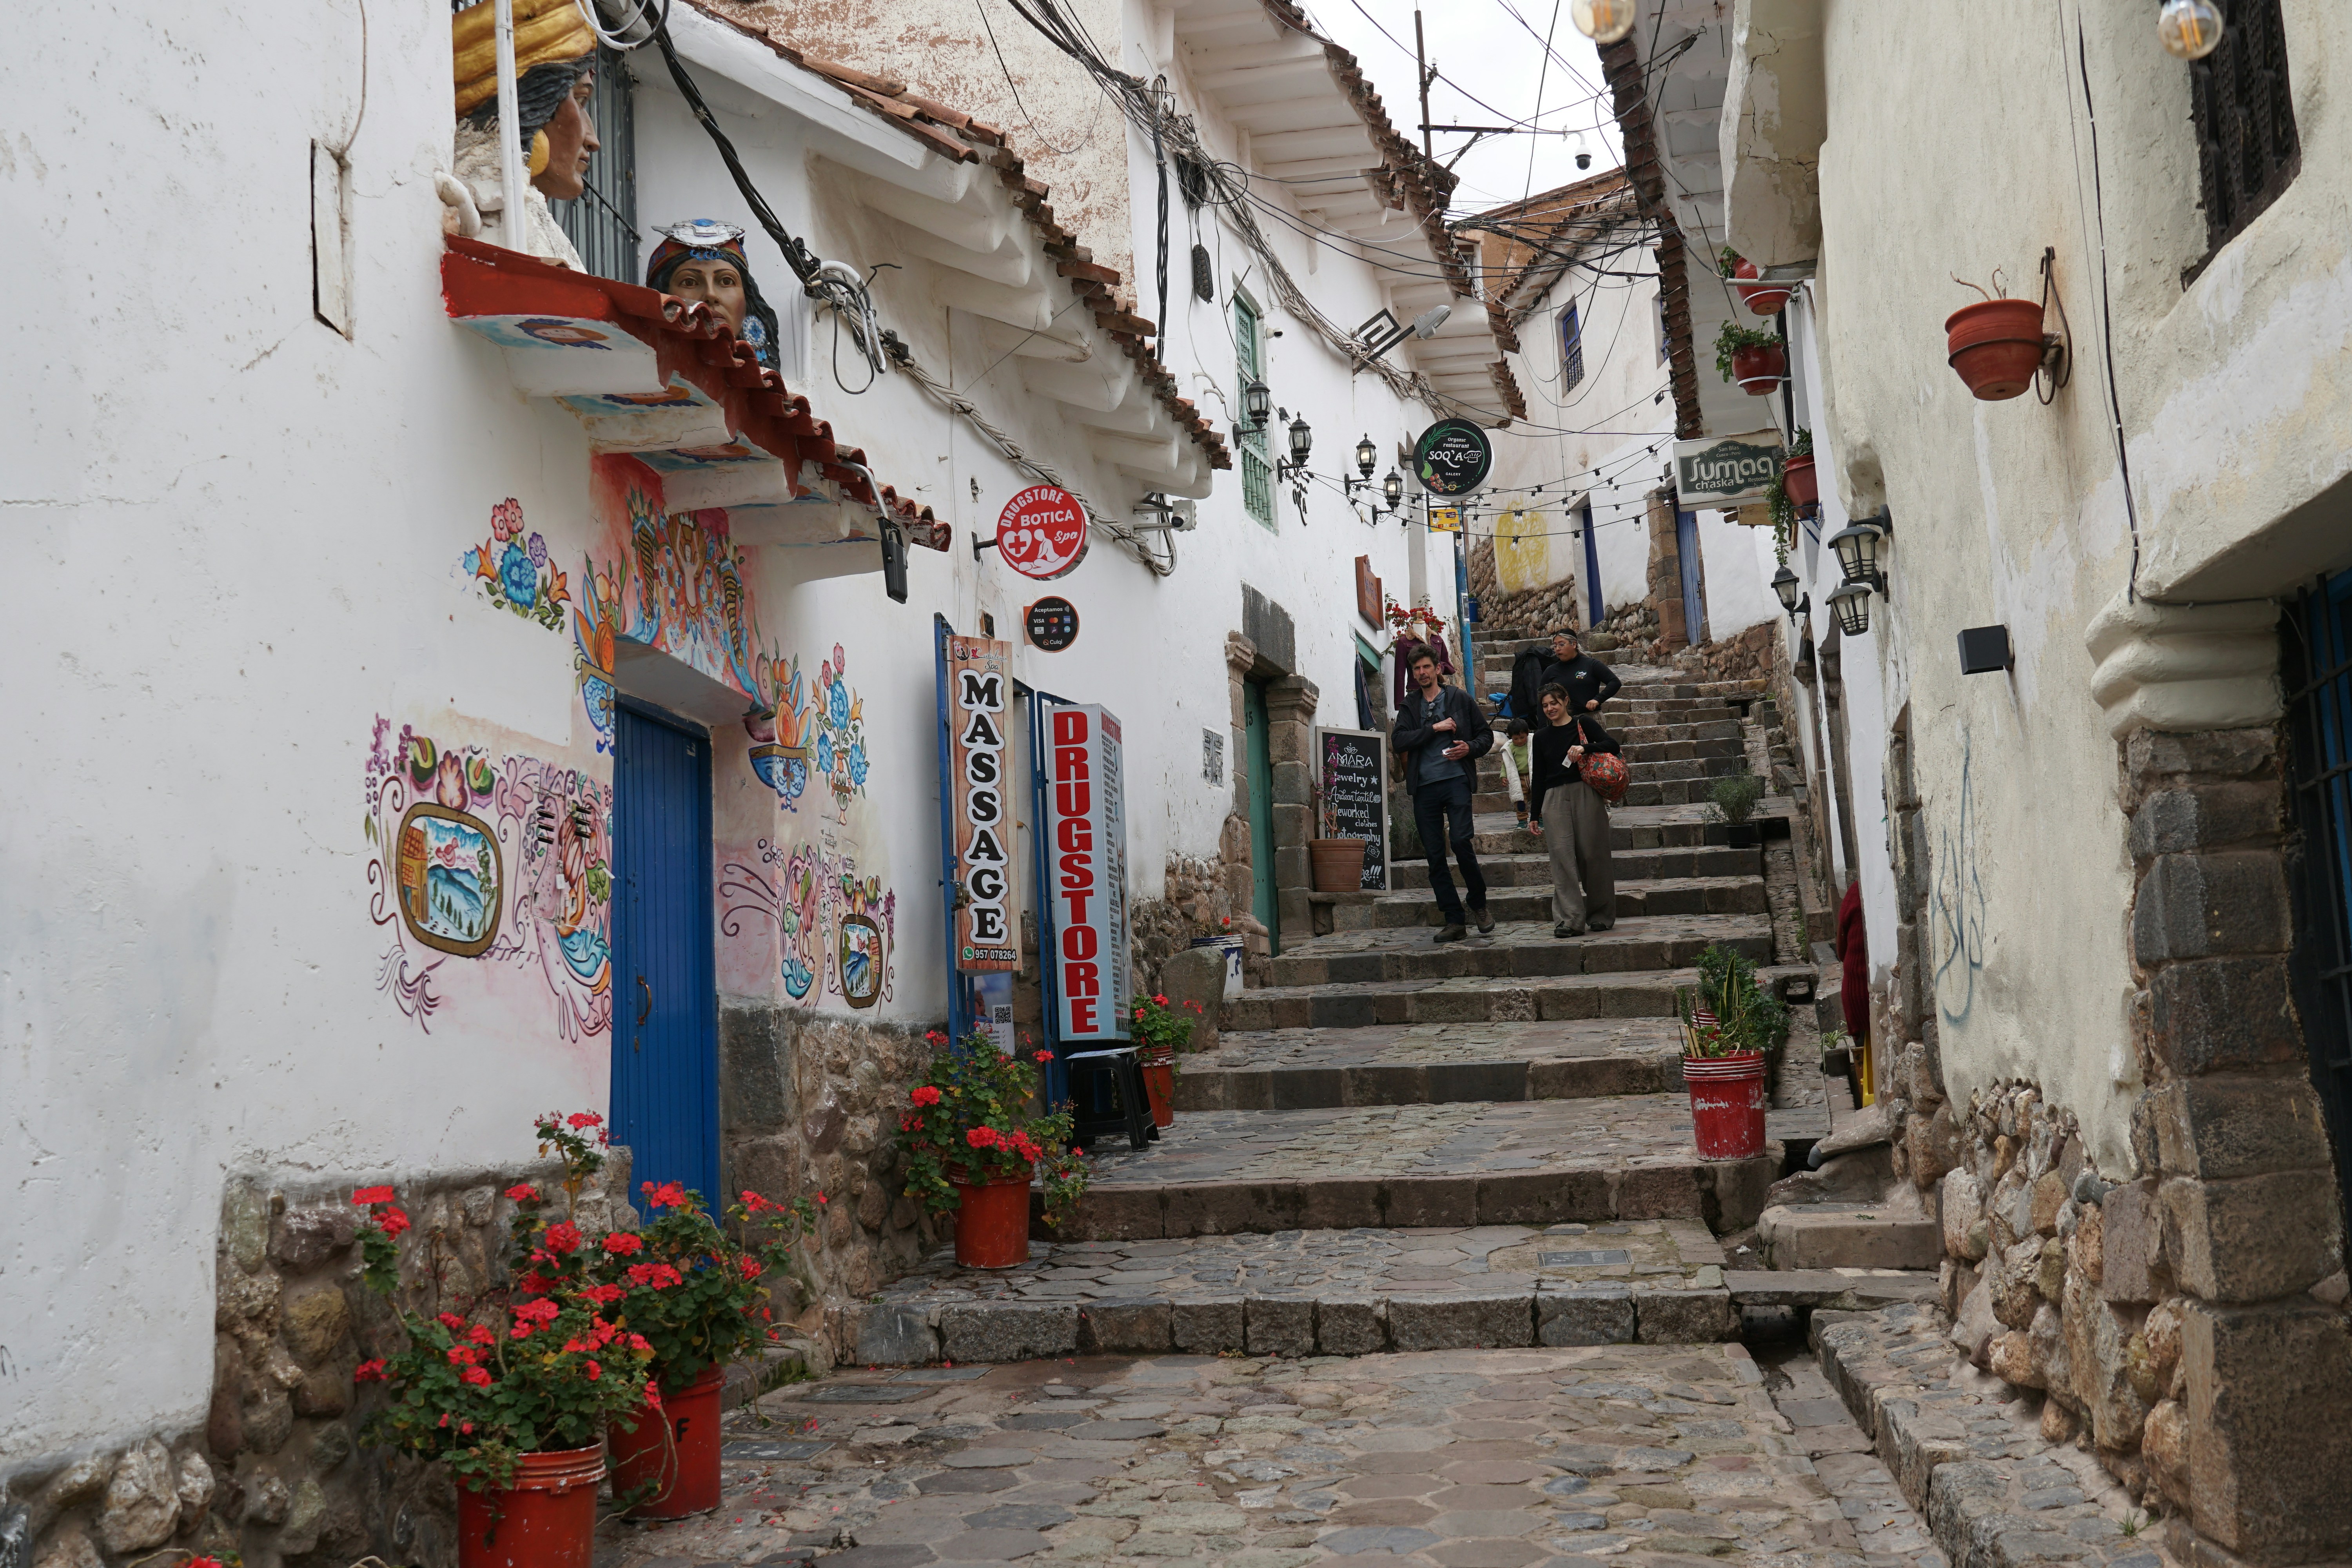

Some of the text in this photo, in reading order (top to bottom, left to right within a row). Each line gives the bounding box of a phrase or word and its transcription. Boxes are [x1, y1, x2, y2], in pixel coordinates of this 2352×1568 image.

[1000, 488, 1064, 528] DRUGSTORE
[1020, 509, 1075, 527] BOTICA
[1054, 530, 1079, 544] Spa
[985, 660, 999, 671] Spa
[1101, 711, 1122, 745] DRUGSTORE
[963, 674, 1004, 939] MASSAGE
[1355, 818, 1377, 828] clothes
[1053, 711, 1099, 1034] DRUGSTORE
[975, 948, 1016, 960] 957 078264
[676, 1417, 690, 1443] F
